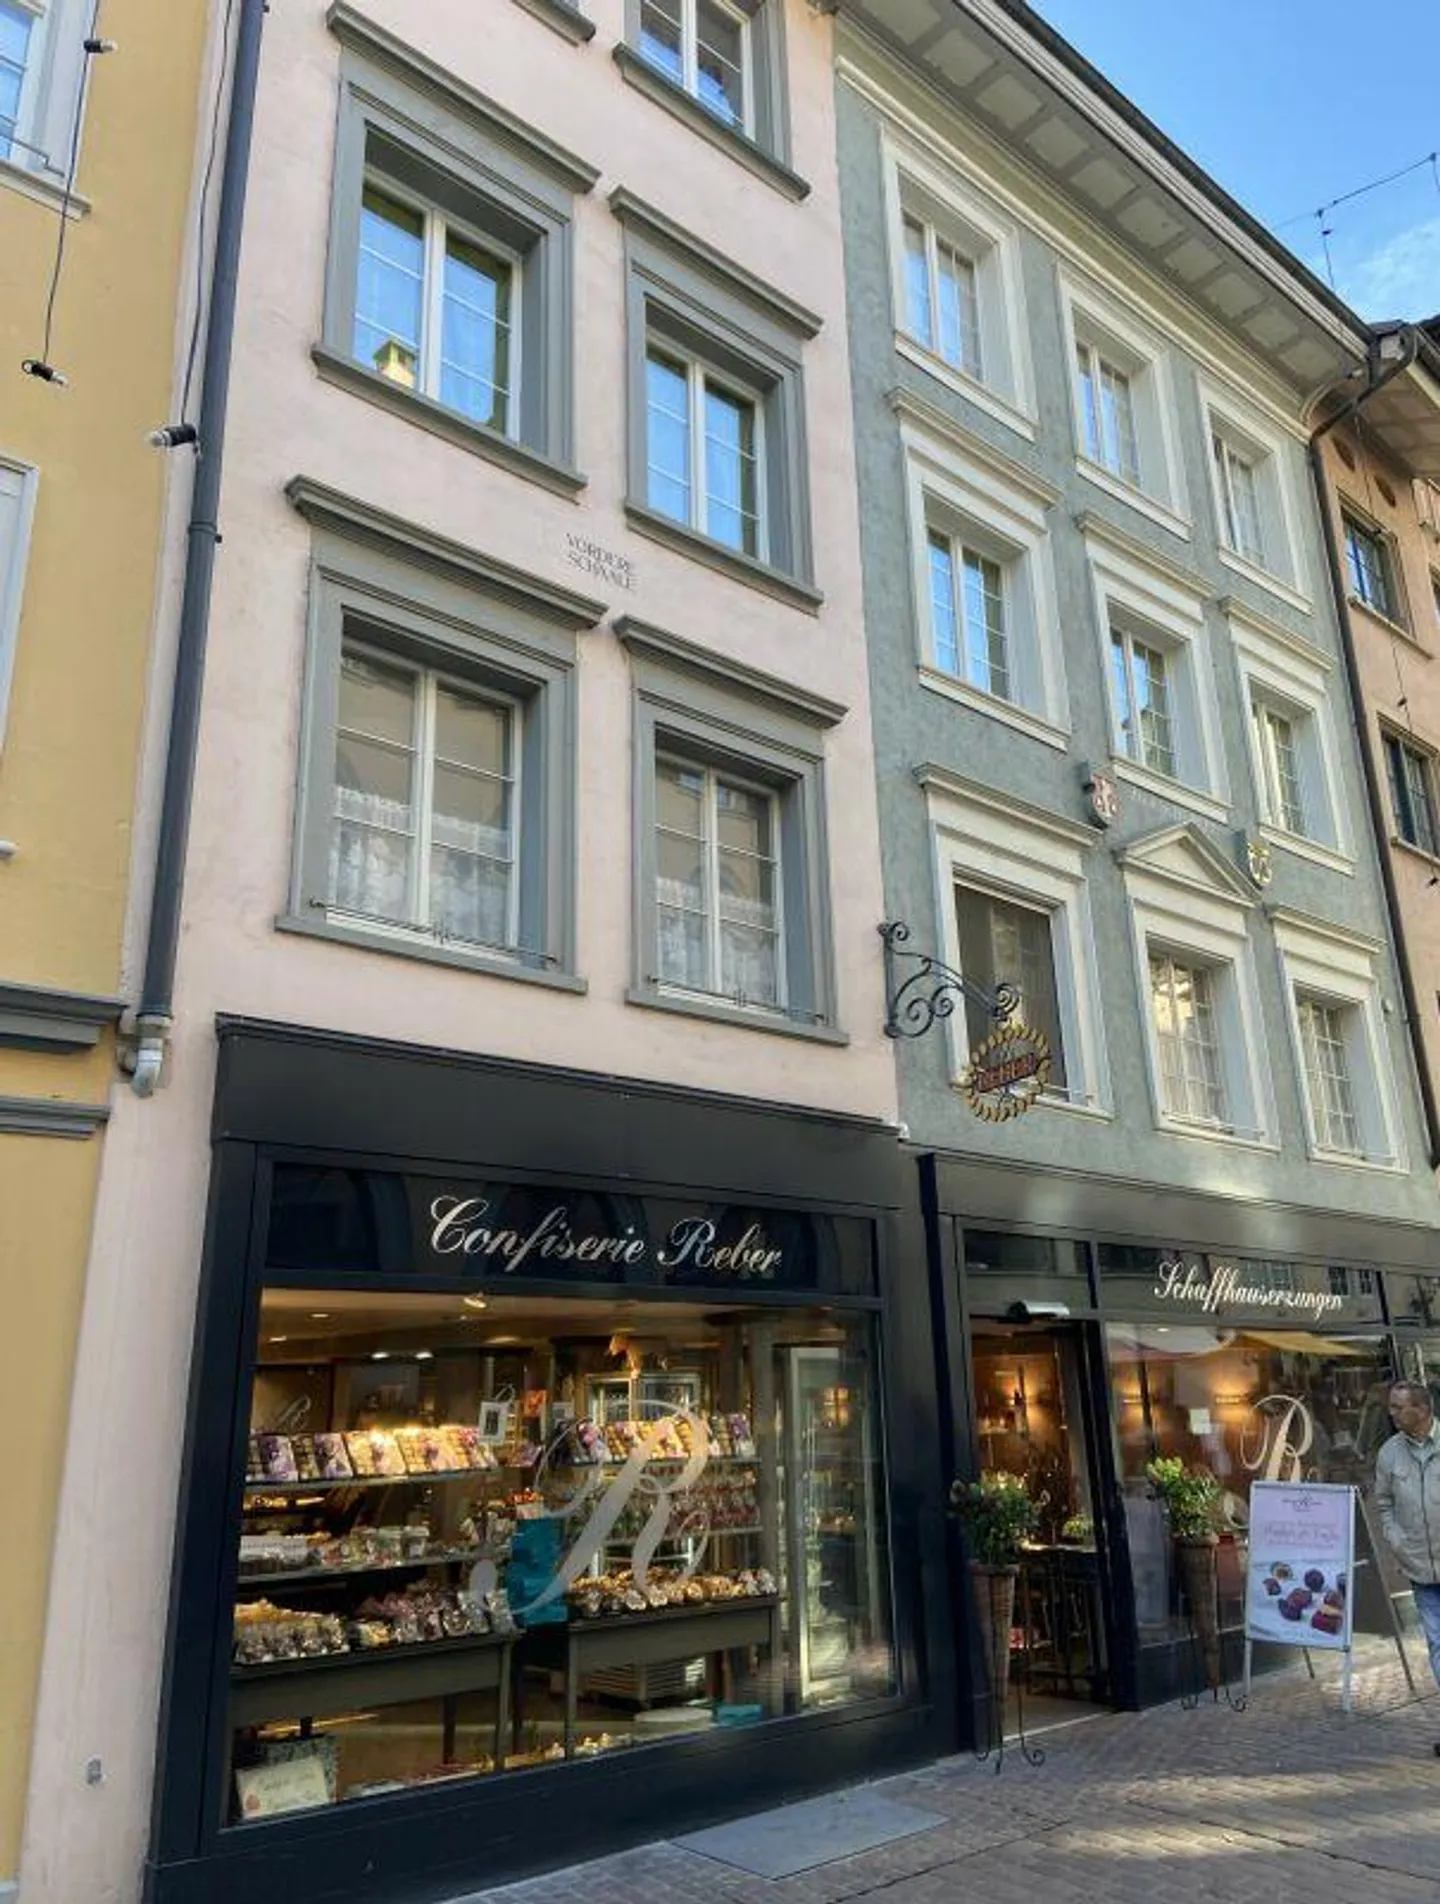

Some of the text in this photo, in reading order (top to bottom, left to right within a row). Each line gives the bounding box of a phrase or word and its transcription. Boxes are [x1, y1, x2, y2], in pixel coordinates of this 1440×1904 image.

[430, 1195, 783, 1272] Confiserie Reber
[1154, 1261, 1344, 1321] Schaffhauserzungen
